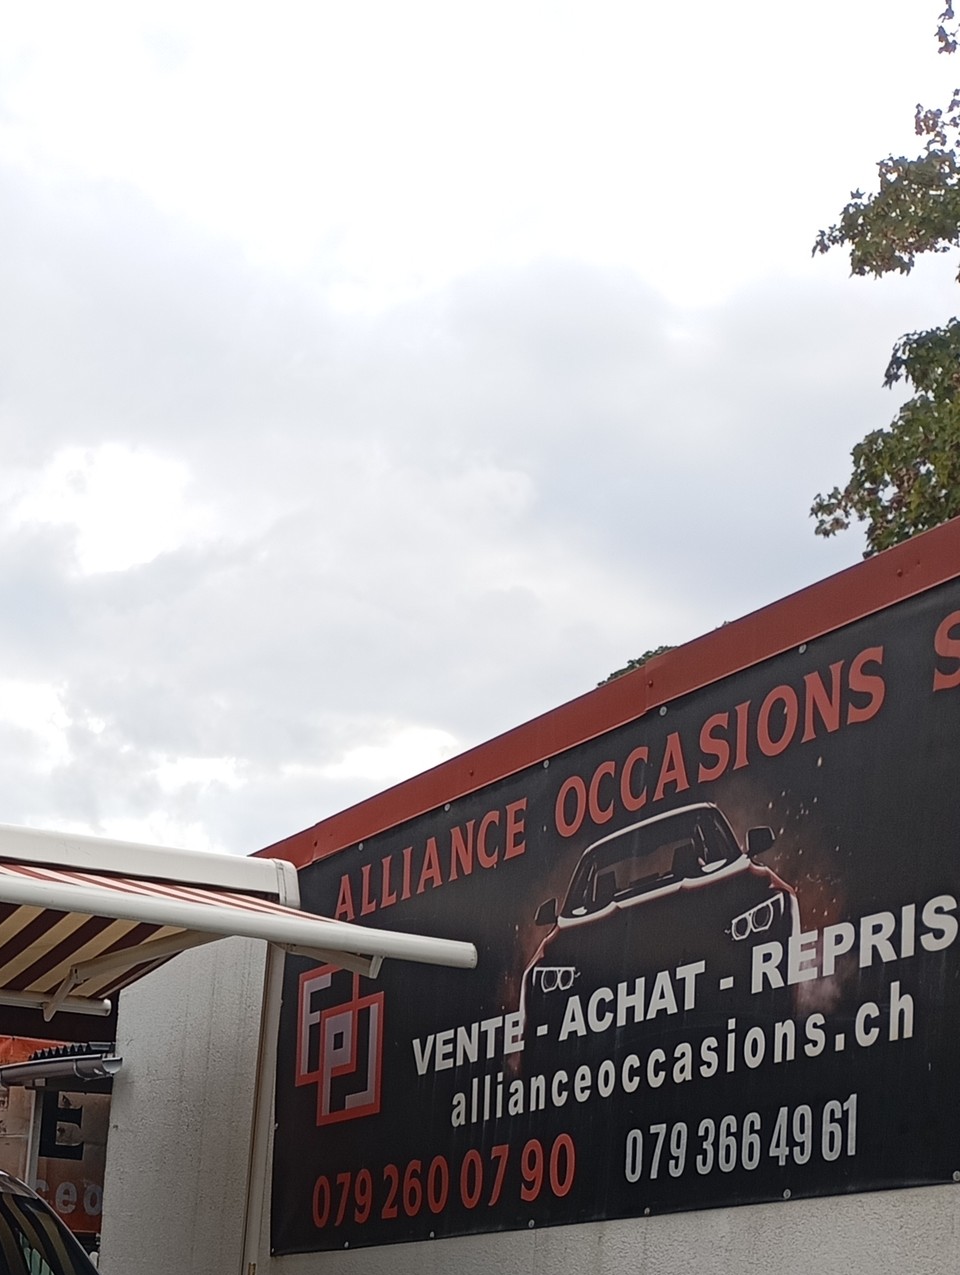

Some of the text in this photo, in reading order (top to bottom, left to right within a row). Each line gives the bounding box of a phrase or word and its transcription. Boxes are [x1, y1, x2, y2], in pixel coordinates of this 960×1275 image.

[334, 797, 528, 922] ALLIANCE
[554, 645, 886, 838] OCCASIONS
[411, 1010, 526, 1076] VENTE
[558, 959, 707, 1042] ACHAT
[750, 894, 960, 995] REPRIS
[451, 981, 915, 1128] allianceoccasions.ch
[312, 1132, 576, 1228] 079 260 07 90
[624, 1093, 858, 1183] 079 366 49 61
